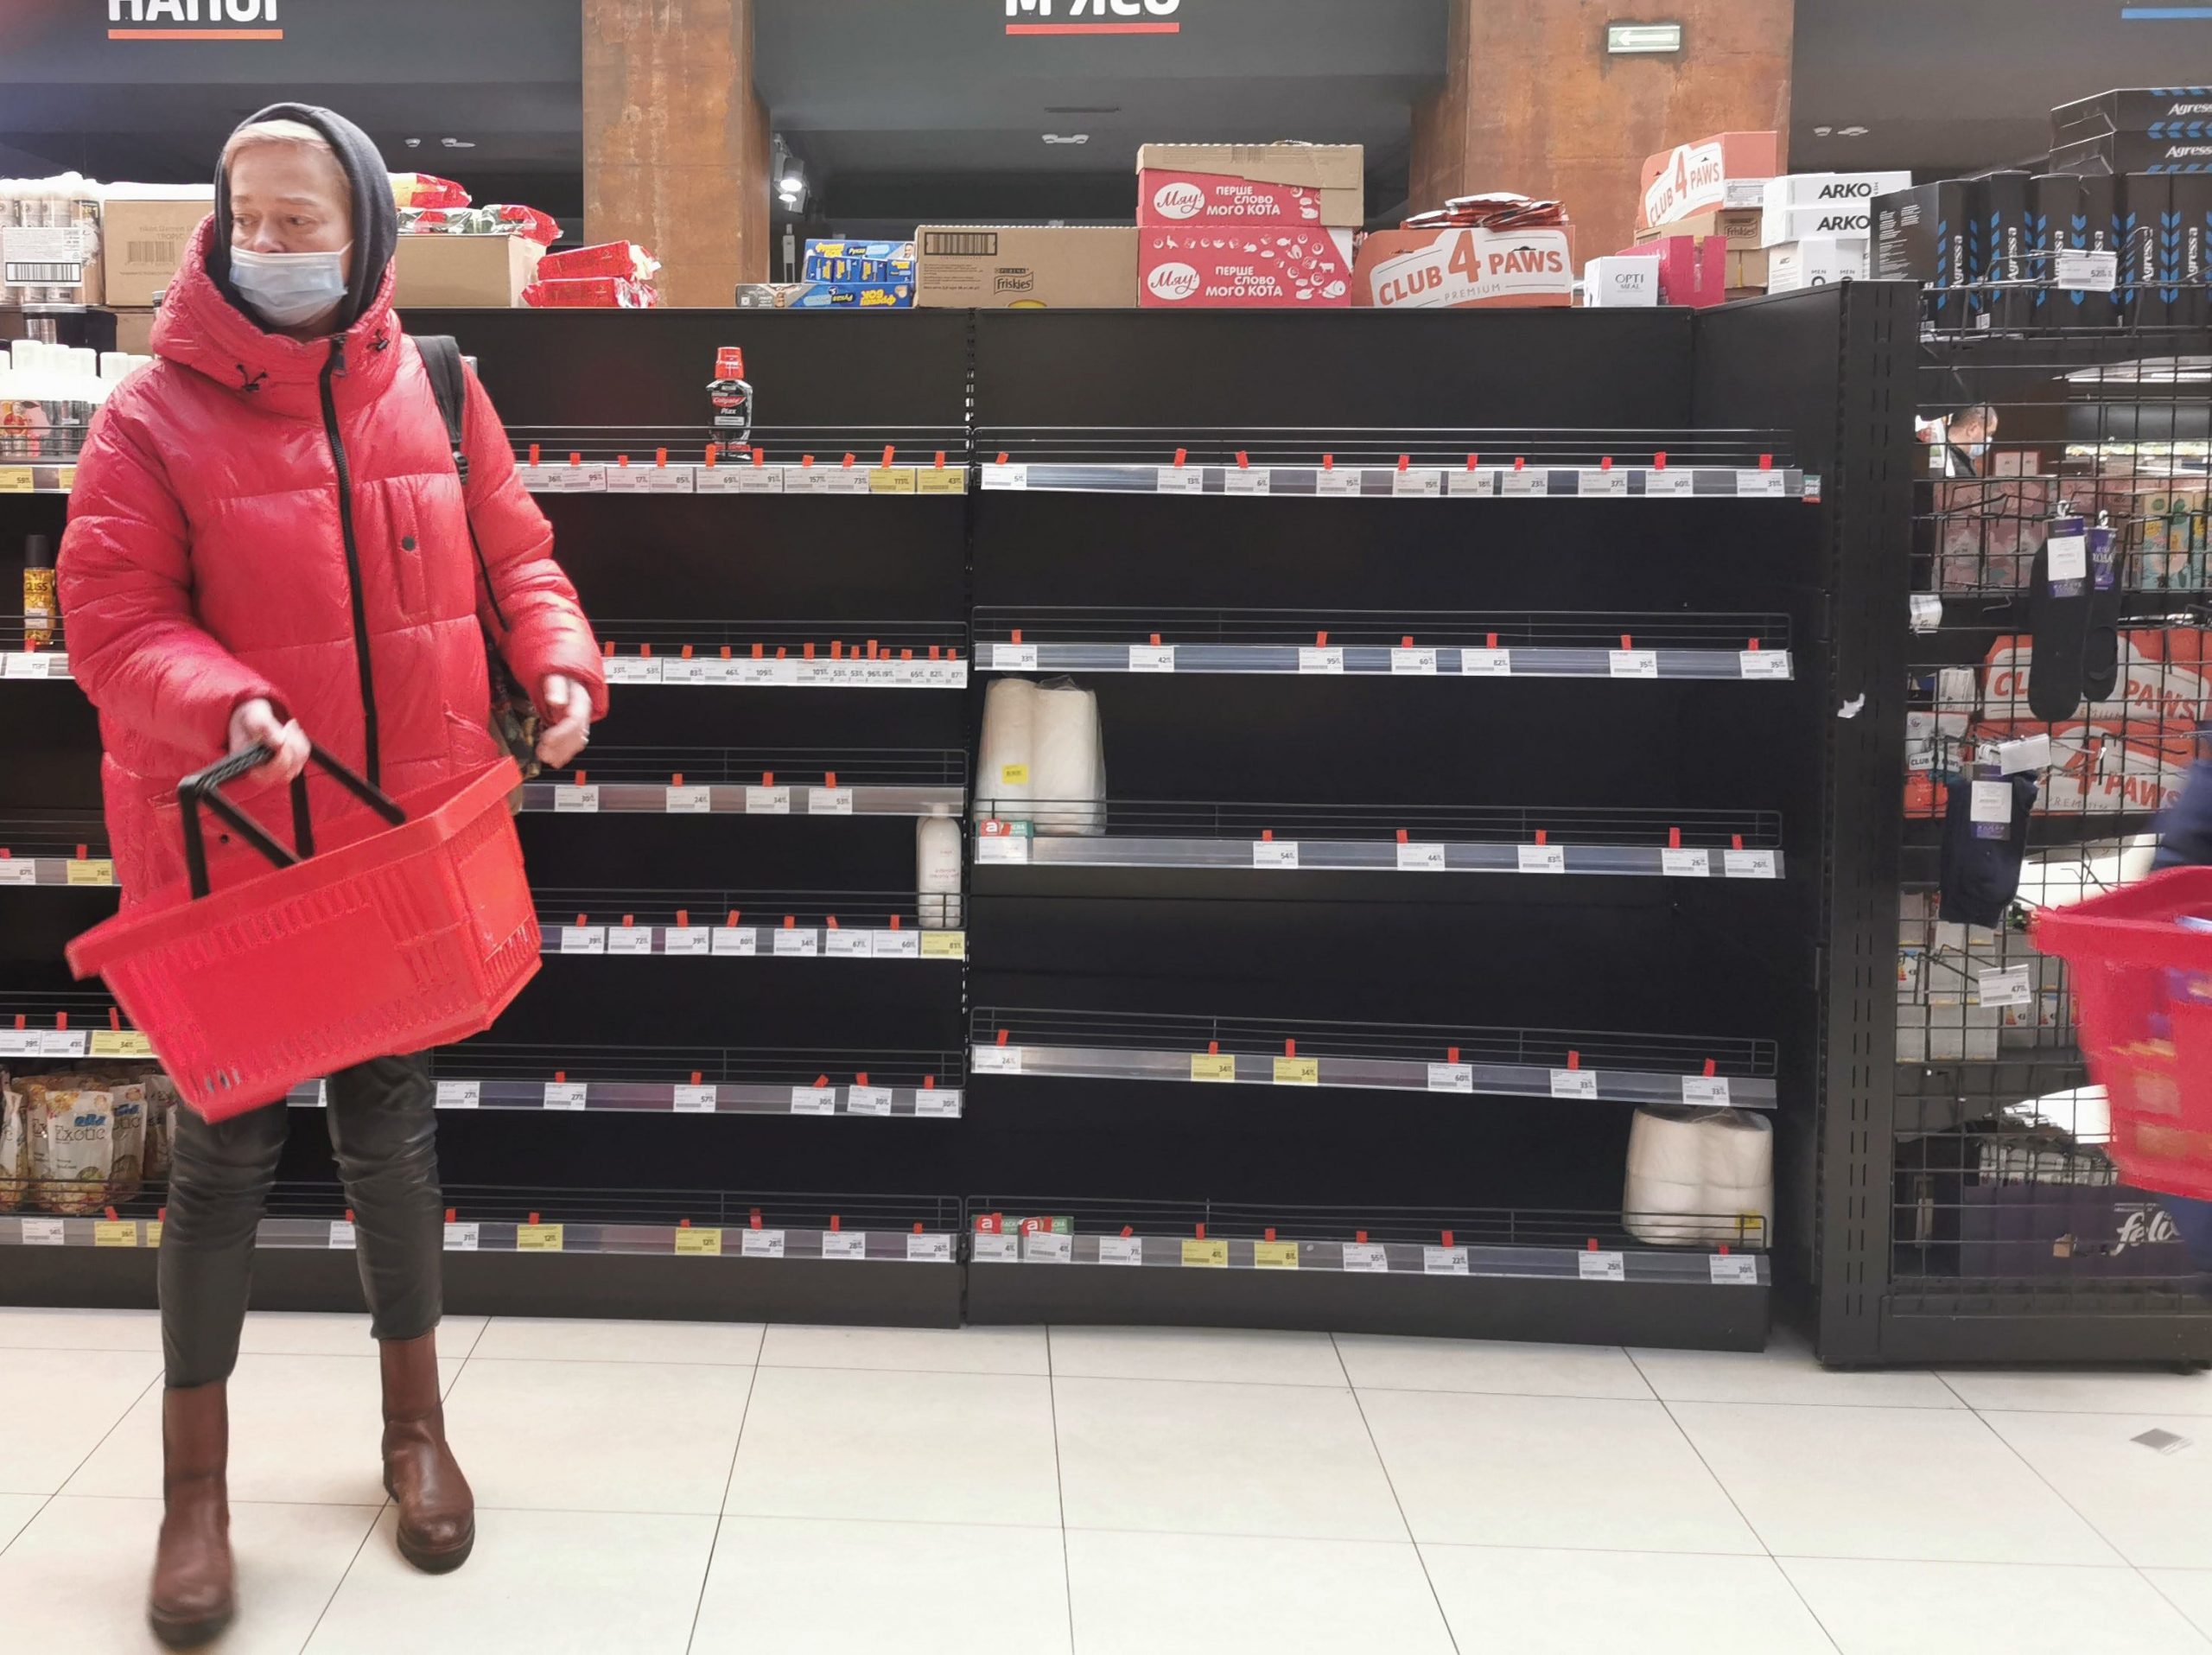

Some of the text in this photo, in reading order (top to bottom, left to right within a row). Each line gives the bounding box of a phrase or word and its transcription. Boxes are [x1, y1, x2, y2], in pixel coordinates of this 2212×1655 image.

[1216, 186, 1253, 195] ПЕРШЕ
[1649, 188, 1674, 226] CLUB
[1675, 150, 1688, 199] 4
[1690, 162, 1719, 190] PAWS
[1817, 182, 1872, 199] ARKO
[1234, 194, 1274, 205] СЛОВО
[1206, 204, 1281, 215] МОГО КОТА
[1816, 215, 1872, 232] ARKO
[1215, 265, 1254, 276] ПЕРШЕ
[1379, 230, 1564, 306] CLUB 4 PAWS
[1234, 276, 1275, 286] СЛОВО
[1615, 273, 1644, 283] OPTI
[997, 278, 1031, 290] Friskies
[1205, 286, 1283, 297] МОГО КОТА
[1445, 283, 1501, 302] PREMIUM
[54, 1124, 105, 1141] Exotic
